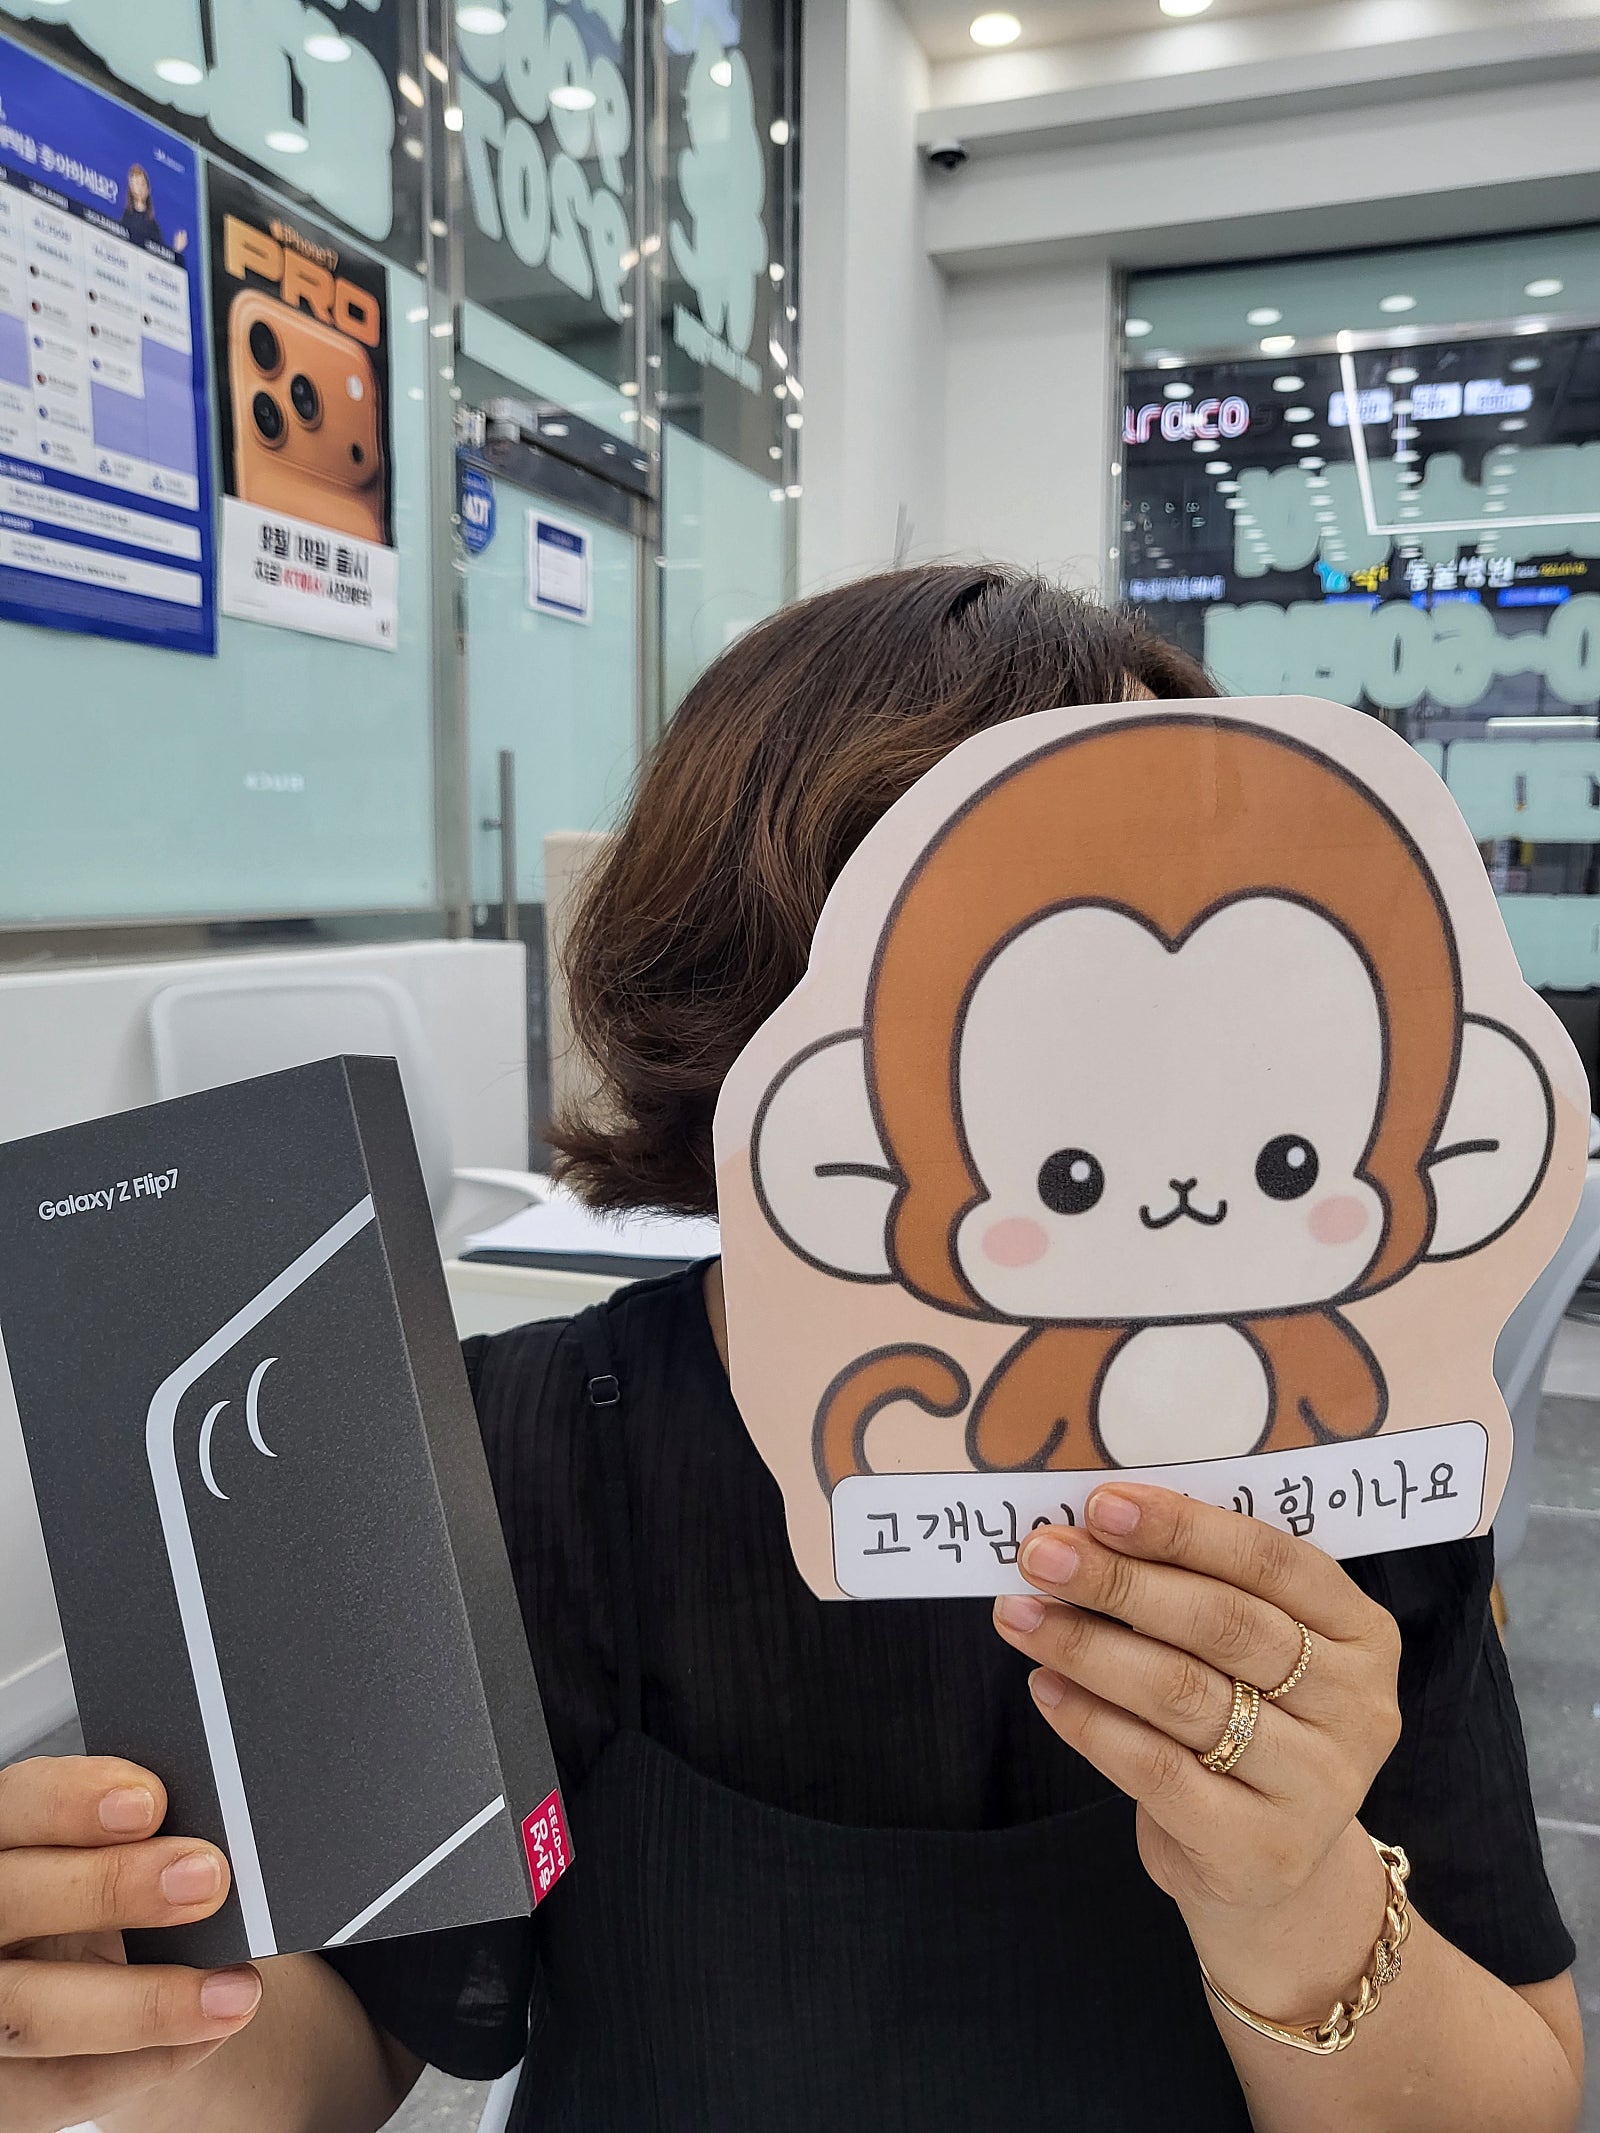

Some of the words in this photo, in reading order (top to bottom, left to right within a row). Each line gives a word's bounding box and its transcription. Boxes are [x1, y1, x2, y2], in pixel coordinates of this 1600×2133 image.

[223, 213, 380, 348] PRO
[38, 1187, 115, 1221] Galaxy
[116, 1180, 132, 1202] Z
[132, 1168, 179, 1199] Flip7
[530, 1817, 556, 1891] 한성
